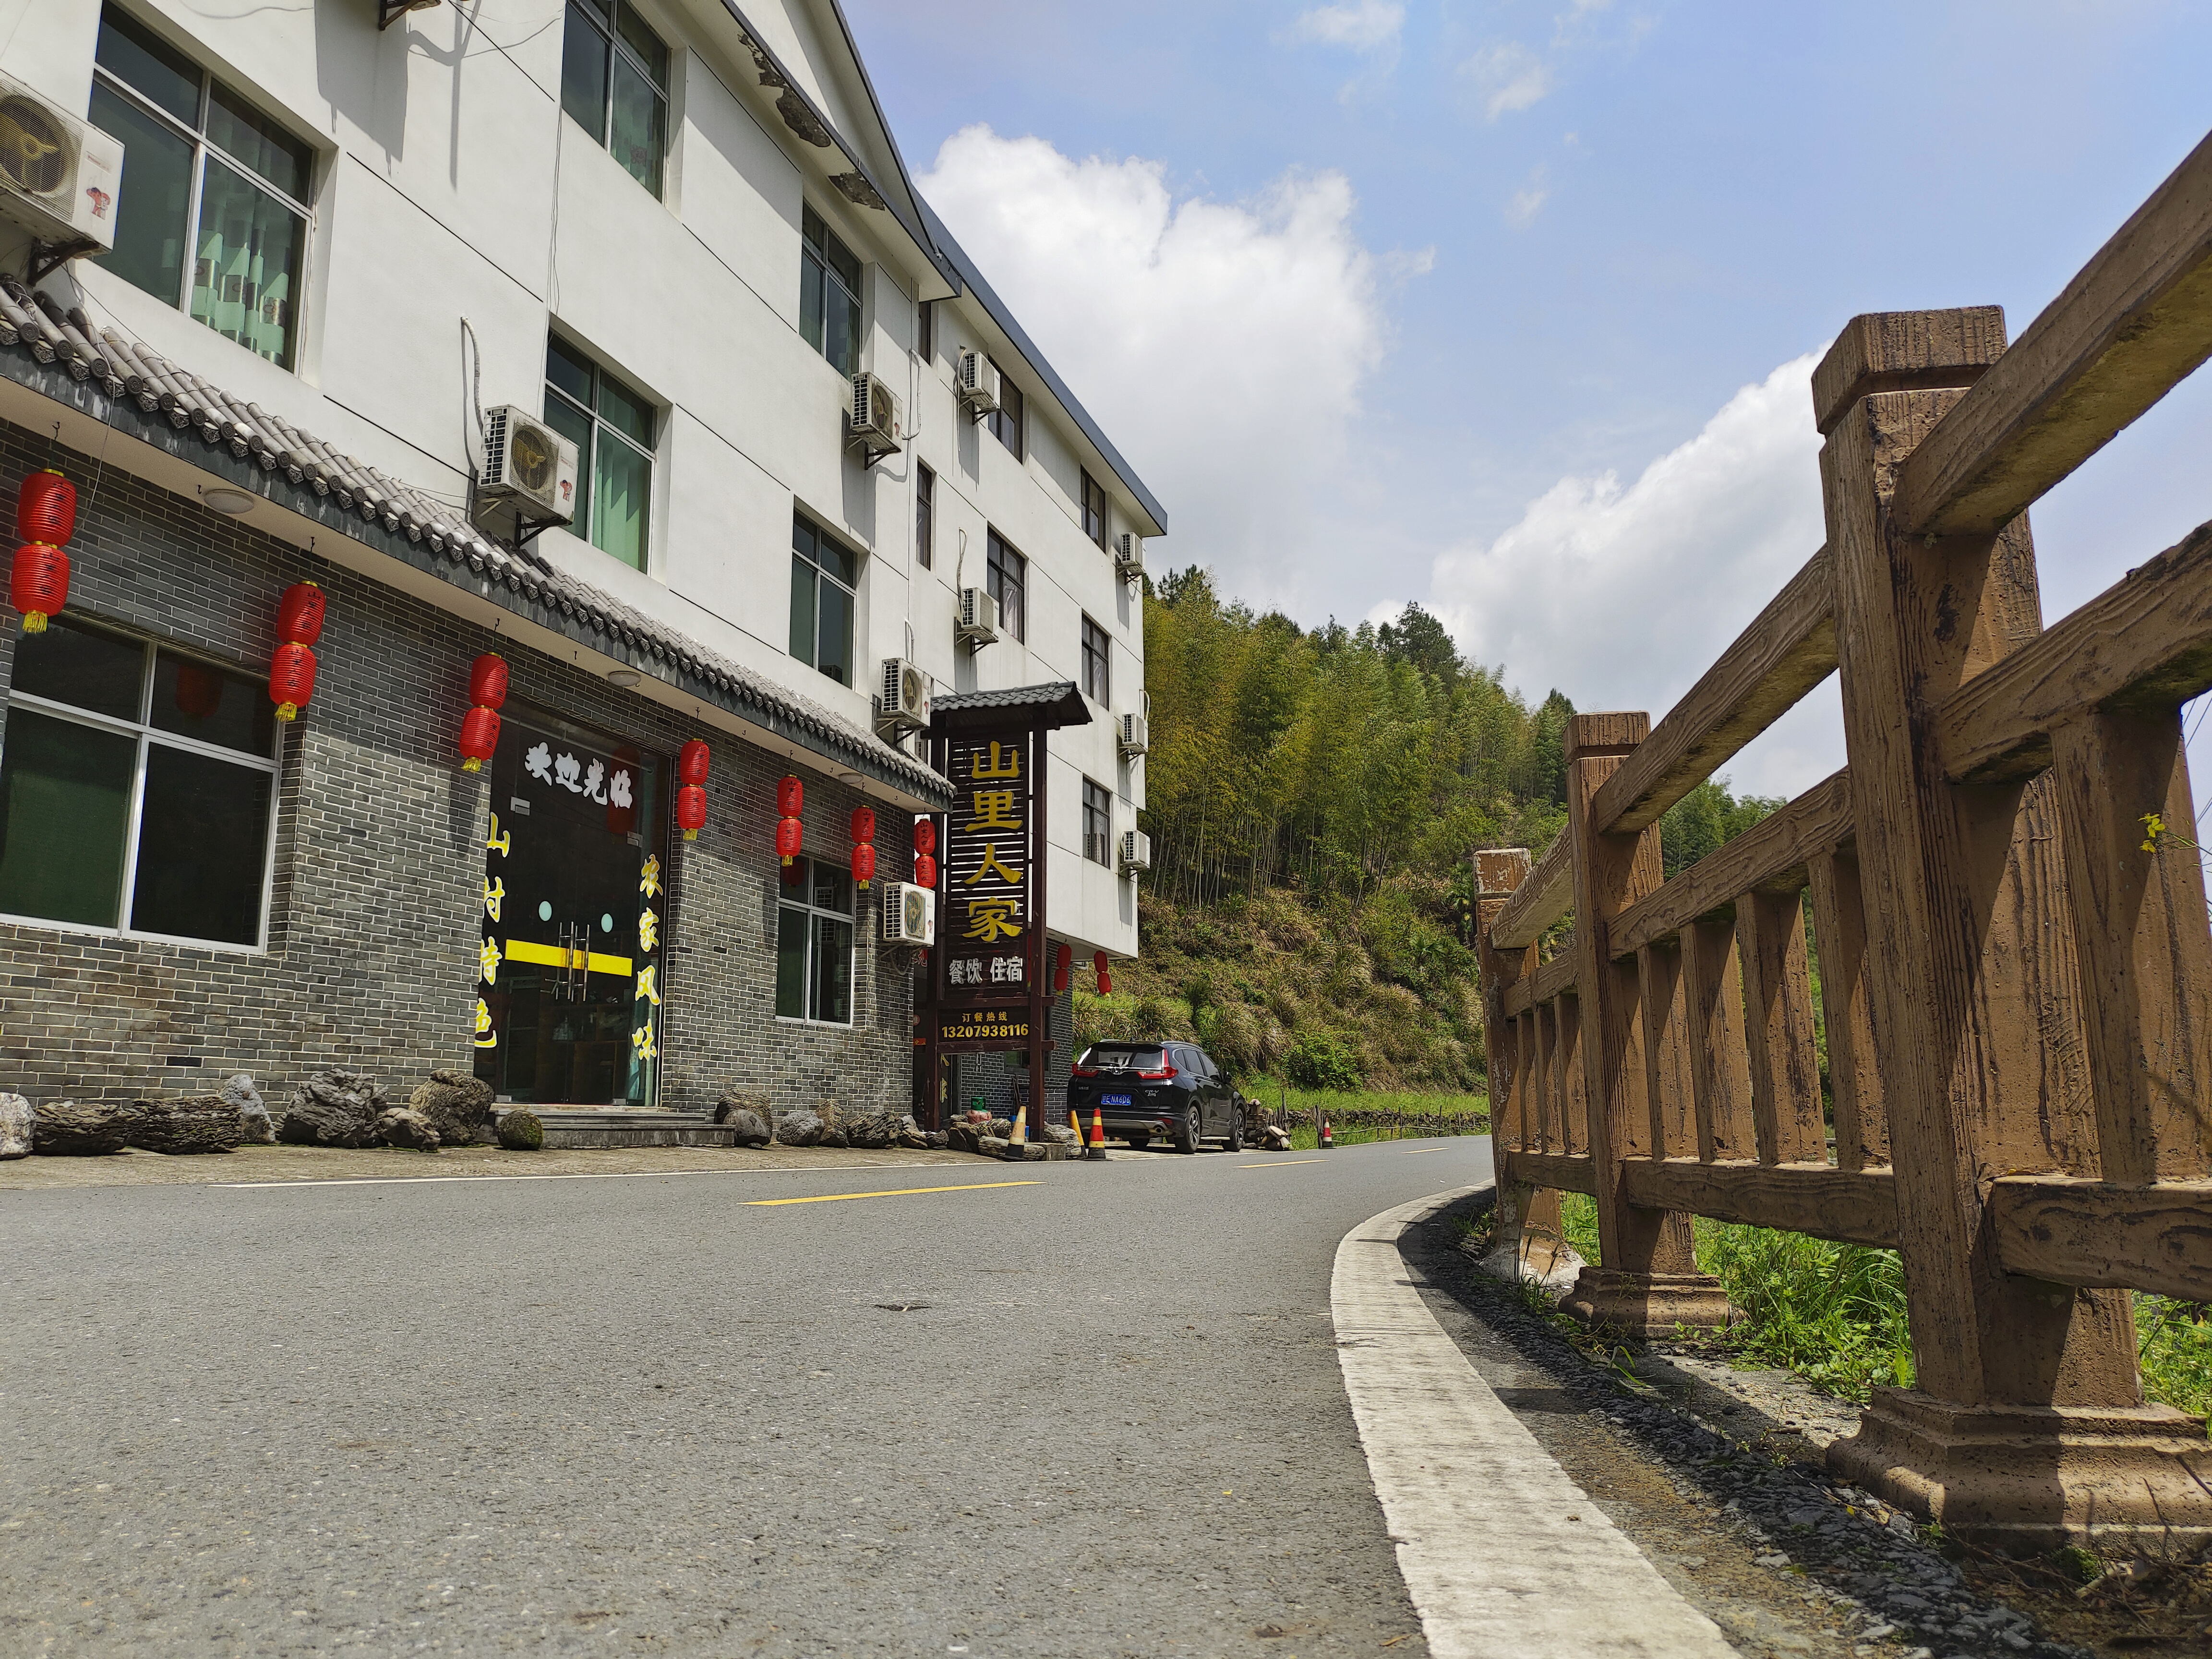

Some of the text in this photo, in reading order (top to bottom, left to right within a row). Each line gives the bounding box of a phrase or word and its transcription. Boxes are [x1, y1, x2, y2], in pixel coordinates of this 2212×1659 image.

[525, 742, 633, 809] 欢迎光临
[962, 740, 1023, 942] 山里人家
[632, 854, 663, 1061] 农家风味
[949, 956, 1023, 984] 餐饮 住宿
[942, 1023, 1029, 1038] 13207938116
[962, 1011, 1008, 1022] 订餐热线
